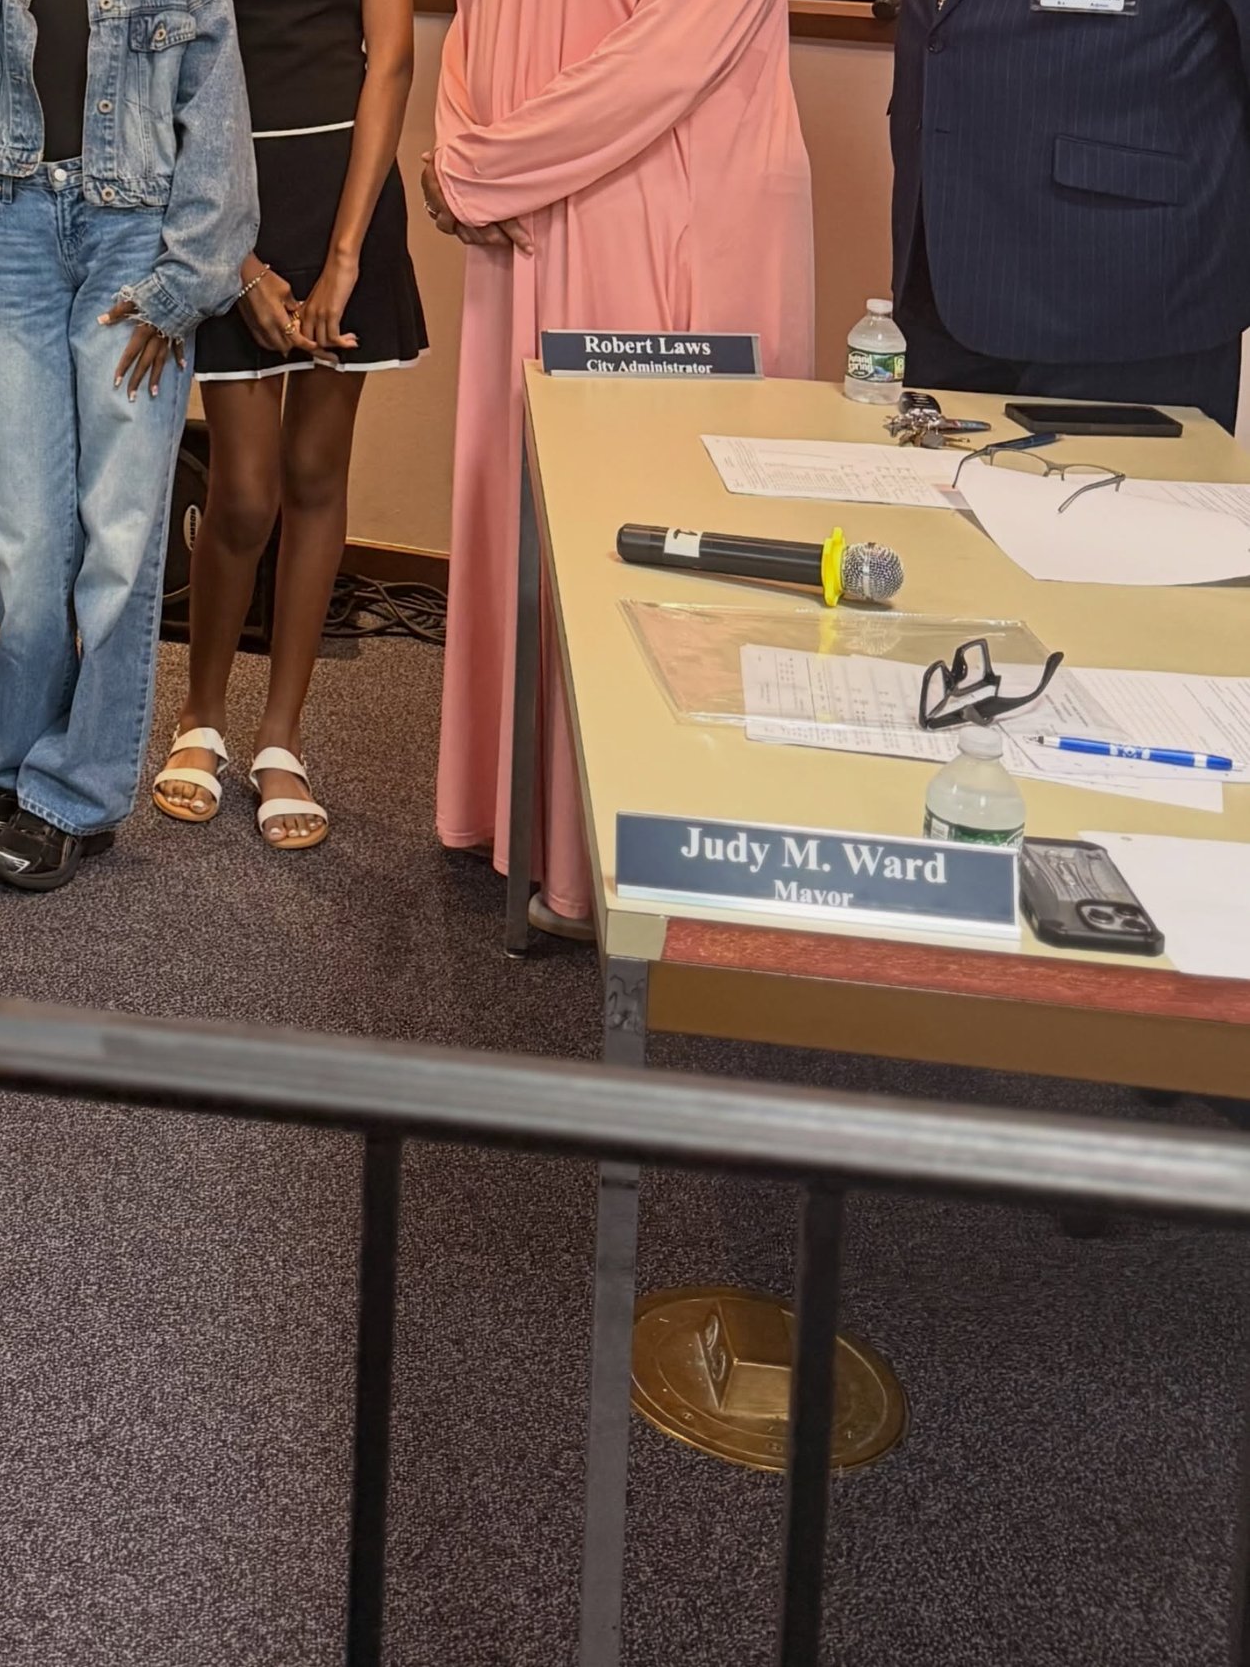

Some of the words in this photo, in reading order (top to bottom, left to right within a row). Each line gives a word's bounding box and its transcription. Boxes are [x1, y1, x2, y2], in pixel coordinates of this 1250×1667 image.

[583, 335, 653, 355] Robert
[659, 337, 711, 356] Laws
[586, 358, 614, 372] City
[618, 359, 713, 375] Administrator
[680, 827, 770, 873] Judy
[781, 836, 831, 872] M.
[842, 842, 947, 885] Ward
[773, 879, 854, 908] Mayor
